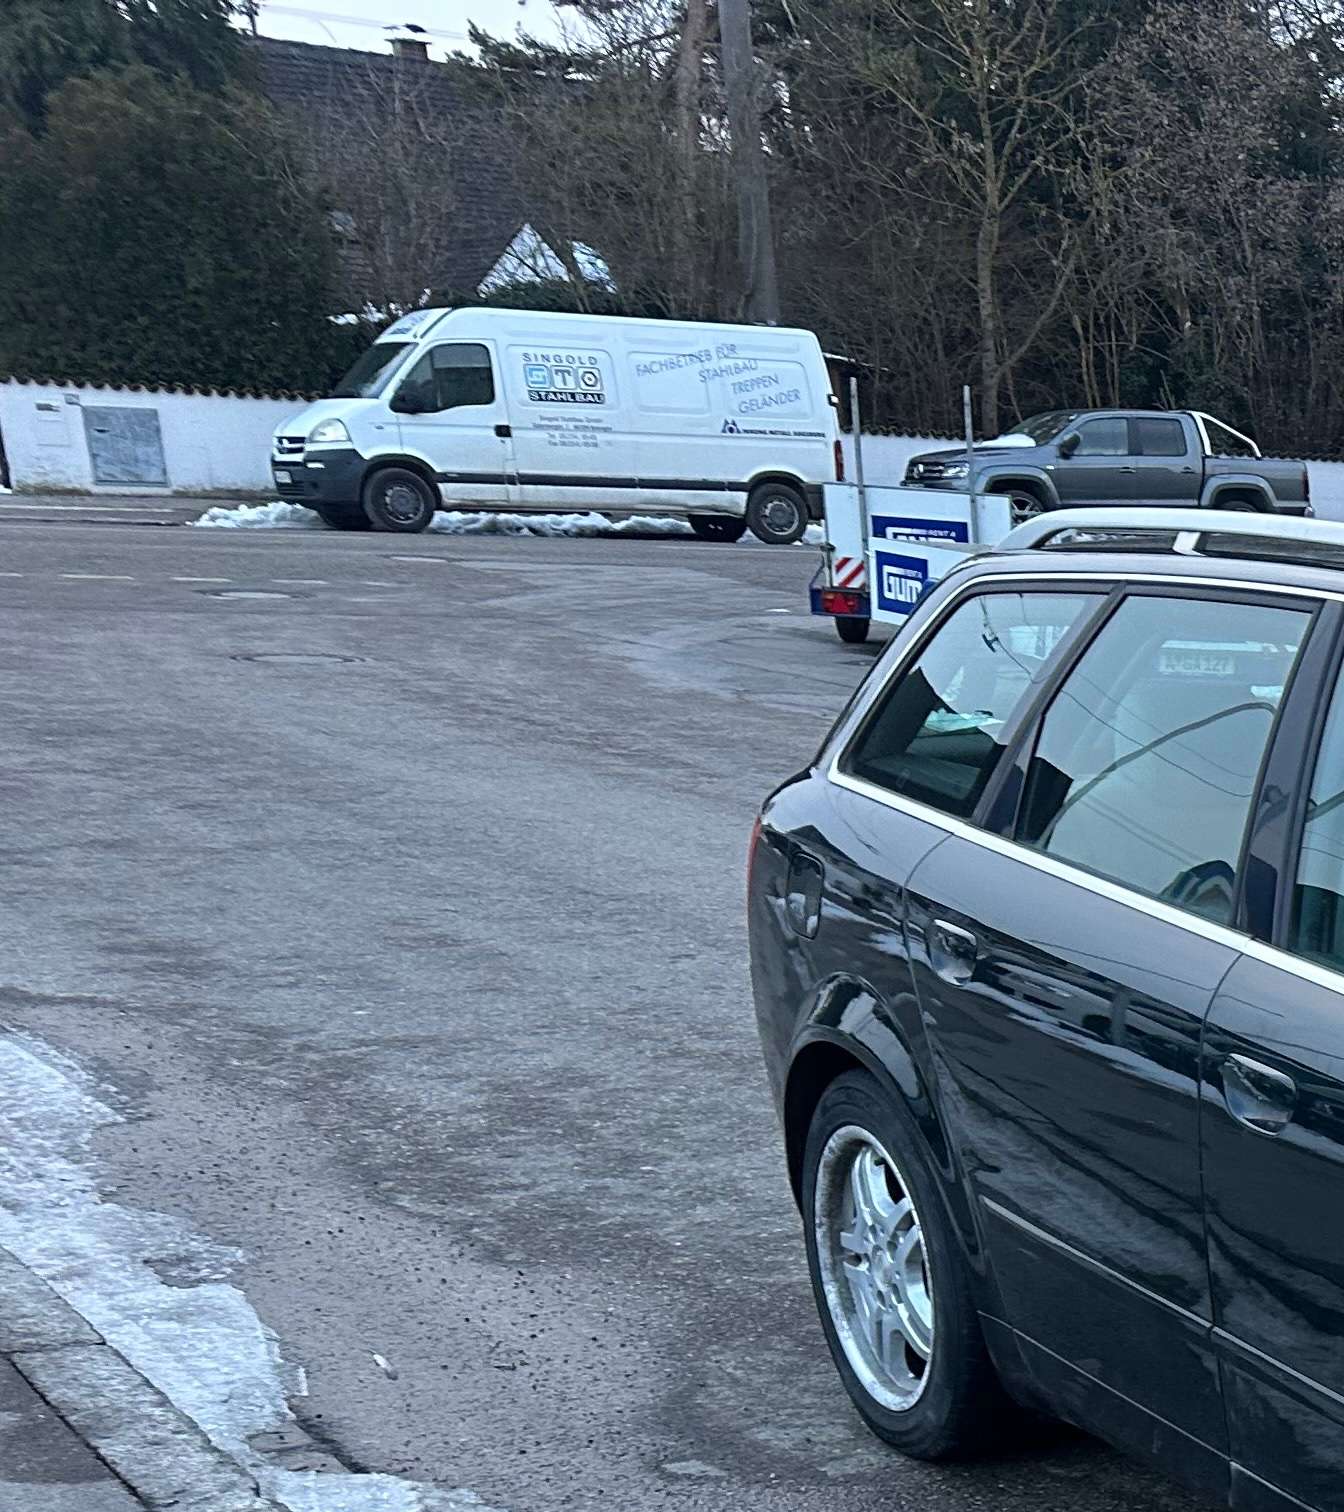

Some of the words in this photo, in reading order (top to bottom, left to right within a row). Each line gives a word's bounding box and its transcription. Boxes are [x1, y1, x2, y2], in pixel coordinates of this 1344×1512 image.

[521, 352, 598, 366] SINGOLD
[636, 349, 712, 376] FACHBETRIEB
[715, 343, 737, 360] FÜR
[699, 360, 759, 383] STAHLBAU
[731, 374, 780, 394] TREPPEN
[529, 391, 605, 403] STAHLBAU
[738, 389, 801, 413] GELÄNDER
